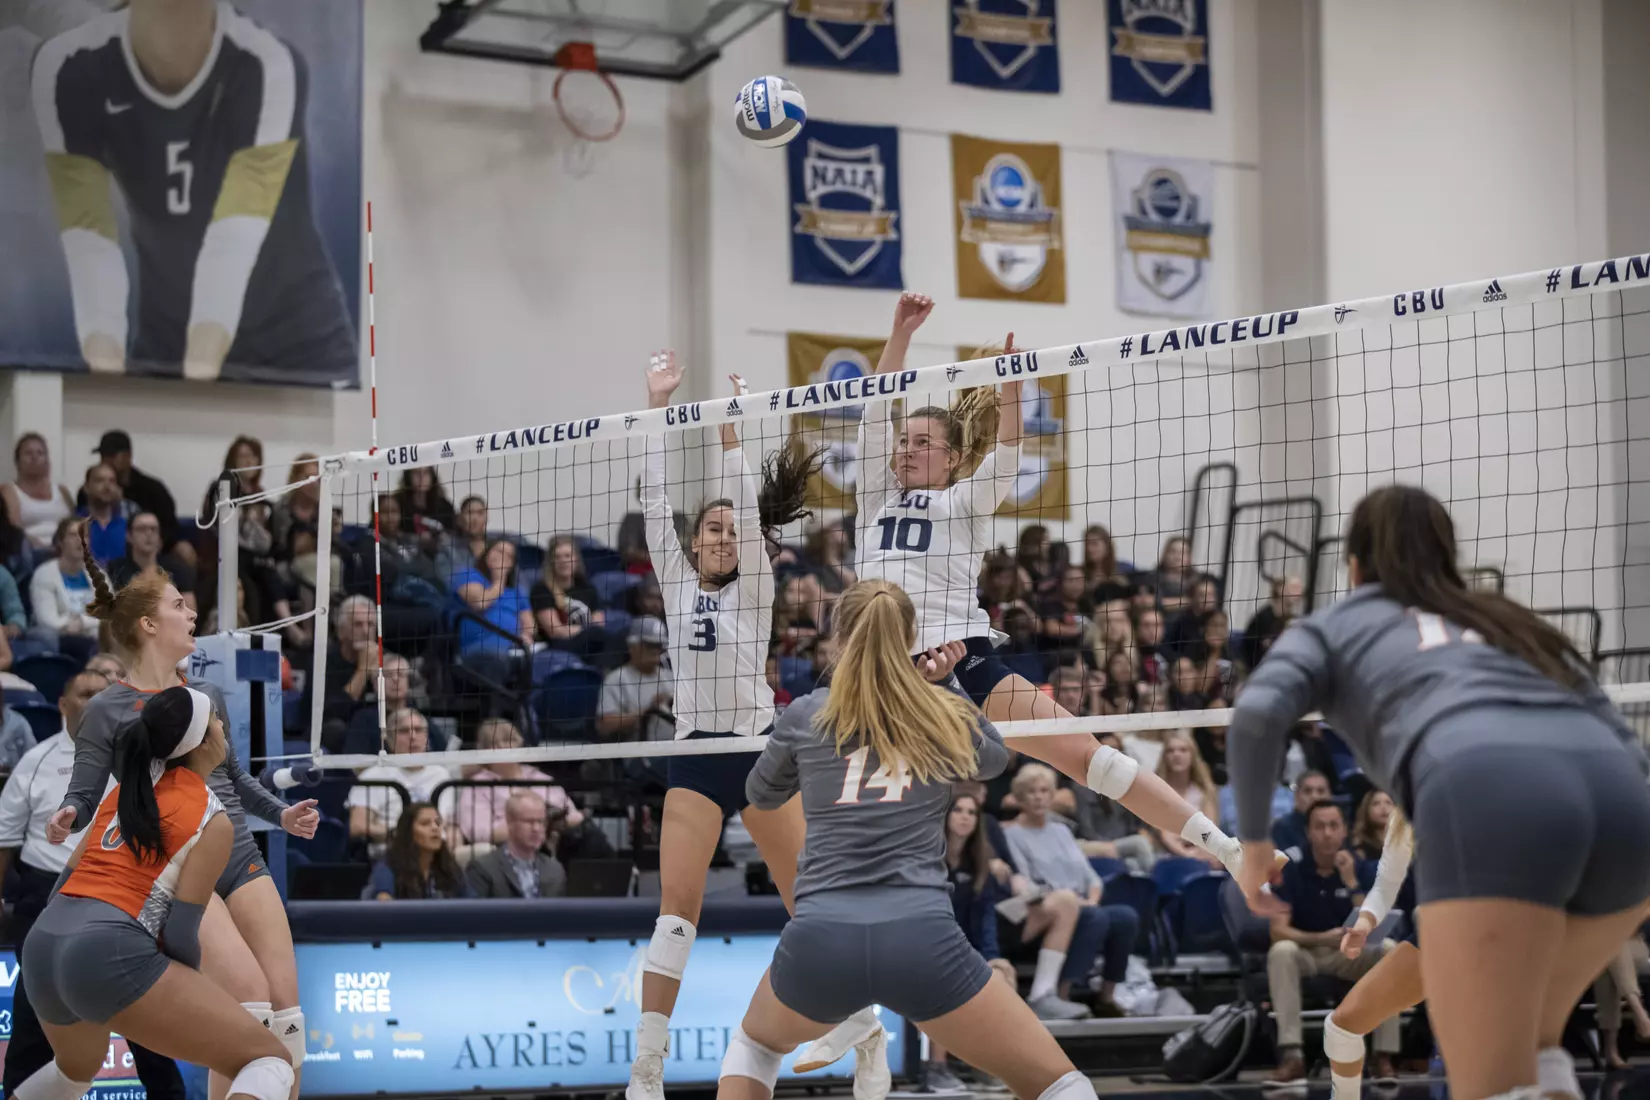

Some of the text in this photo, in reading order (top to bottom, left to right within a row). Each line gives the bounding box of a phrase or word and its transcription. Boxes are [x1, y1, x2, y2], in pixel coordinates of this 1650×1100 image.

[166, 141, 193, 215] 5
[811, 164, 878, 195] NAIA
[1393, 288, 1444, 316] CBU
[1482, 292, 1508, 303] adidas
[1120, 310, 1300, 359] #LANCEUP
[995, 352, 1039, 377] CBU
[1068, 356, 1090, 367] adidas
[769, 370, 917, 411] #LANCEUP
[665, 402, 701, 426] CBU
[475, 418, 601, 453] #LANCEUP
[387, 446, 419, 465] CBU
[878, 516, 933, 552] 10
[688, 617, 717, 652] 3
[833, 745, 914, 804] 14
[335, 971, 391, 990] ENJOY
[335, 988, 391, 1013] FREE
[452, 1030, 588, 1069] AYRES
